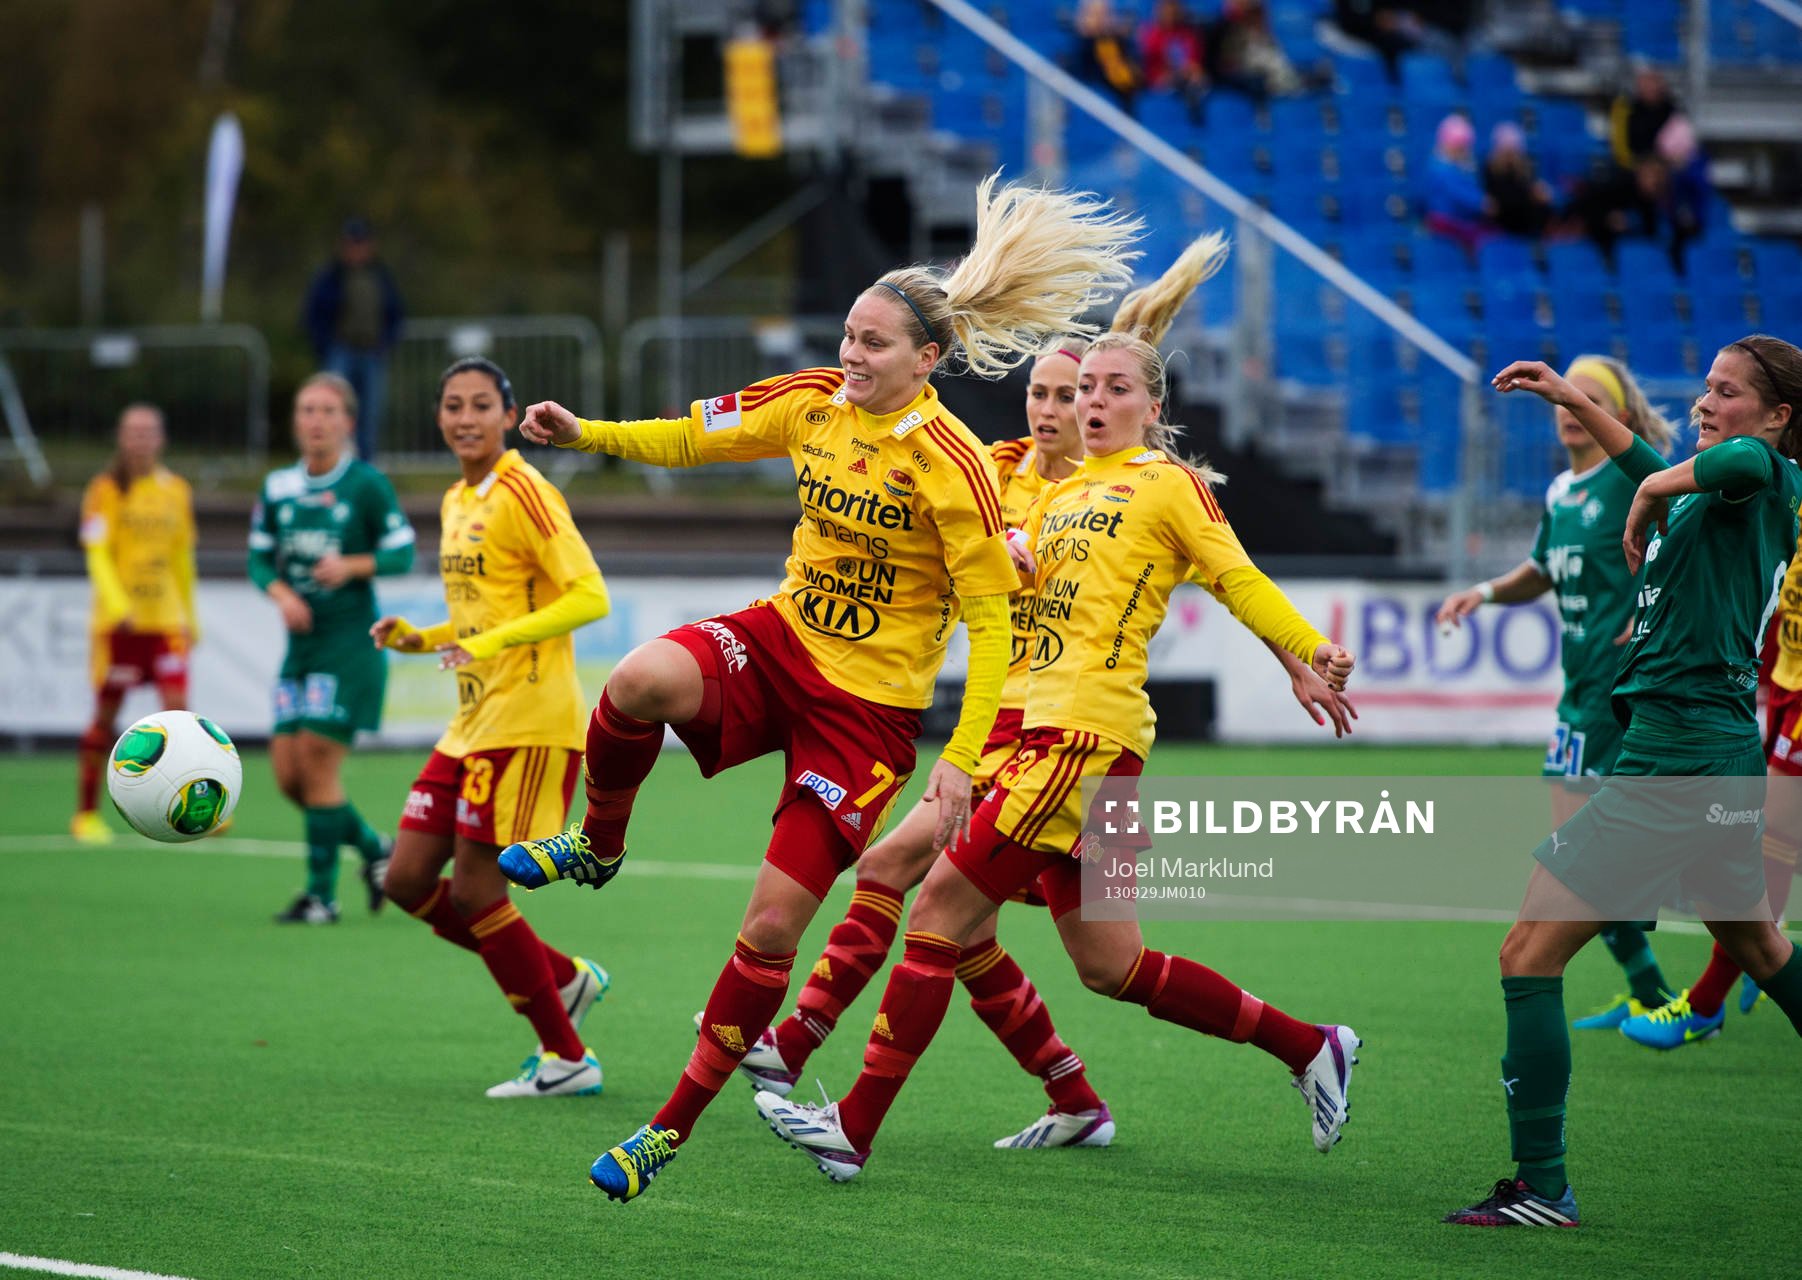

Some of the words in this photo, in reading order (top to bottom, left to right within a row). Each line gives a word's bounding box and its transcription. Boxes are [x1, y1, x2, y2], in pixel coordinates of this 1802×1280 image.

[802, 443, 836, 461] stadium
[798, 464, 913, 531] Prioritet
[804, 503, 890, 560] Finans
[803, 562, 894, 605] WOMEN
[858, 560, 897, 587] UN
[1054, 578, 1080, 600] UN
[802, 591, 860, 635] KIA
[1105, 631, 1125, 670] Oscar
[1118, 562, 1154, 628] Properties
[1360, 598, 1559, 683] BDO
[804, 773, 842, 803] BDO
[853, 760, 896, 809] 7
